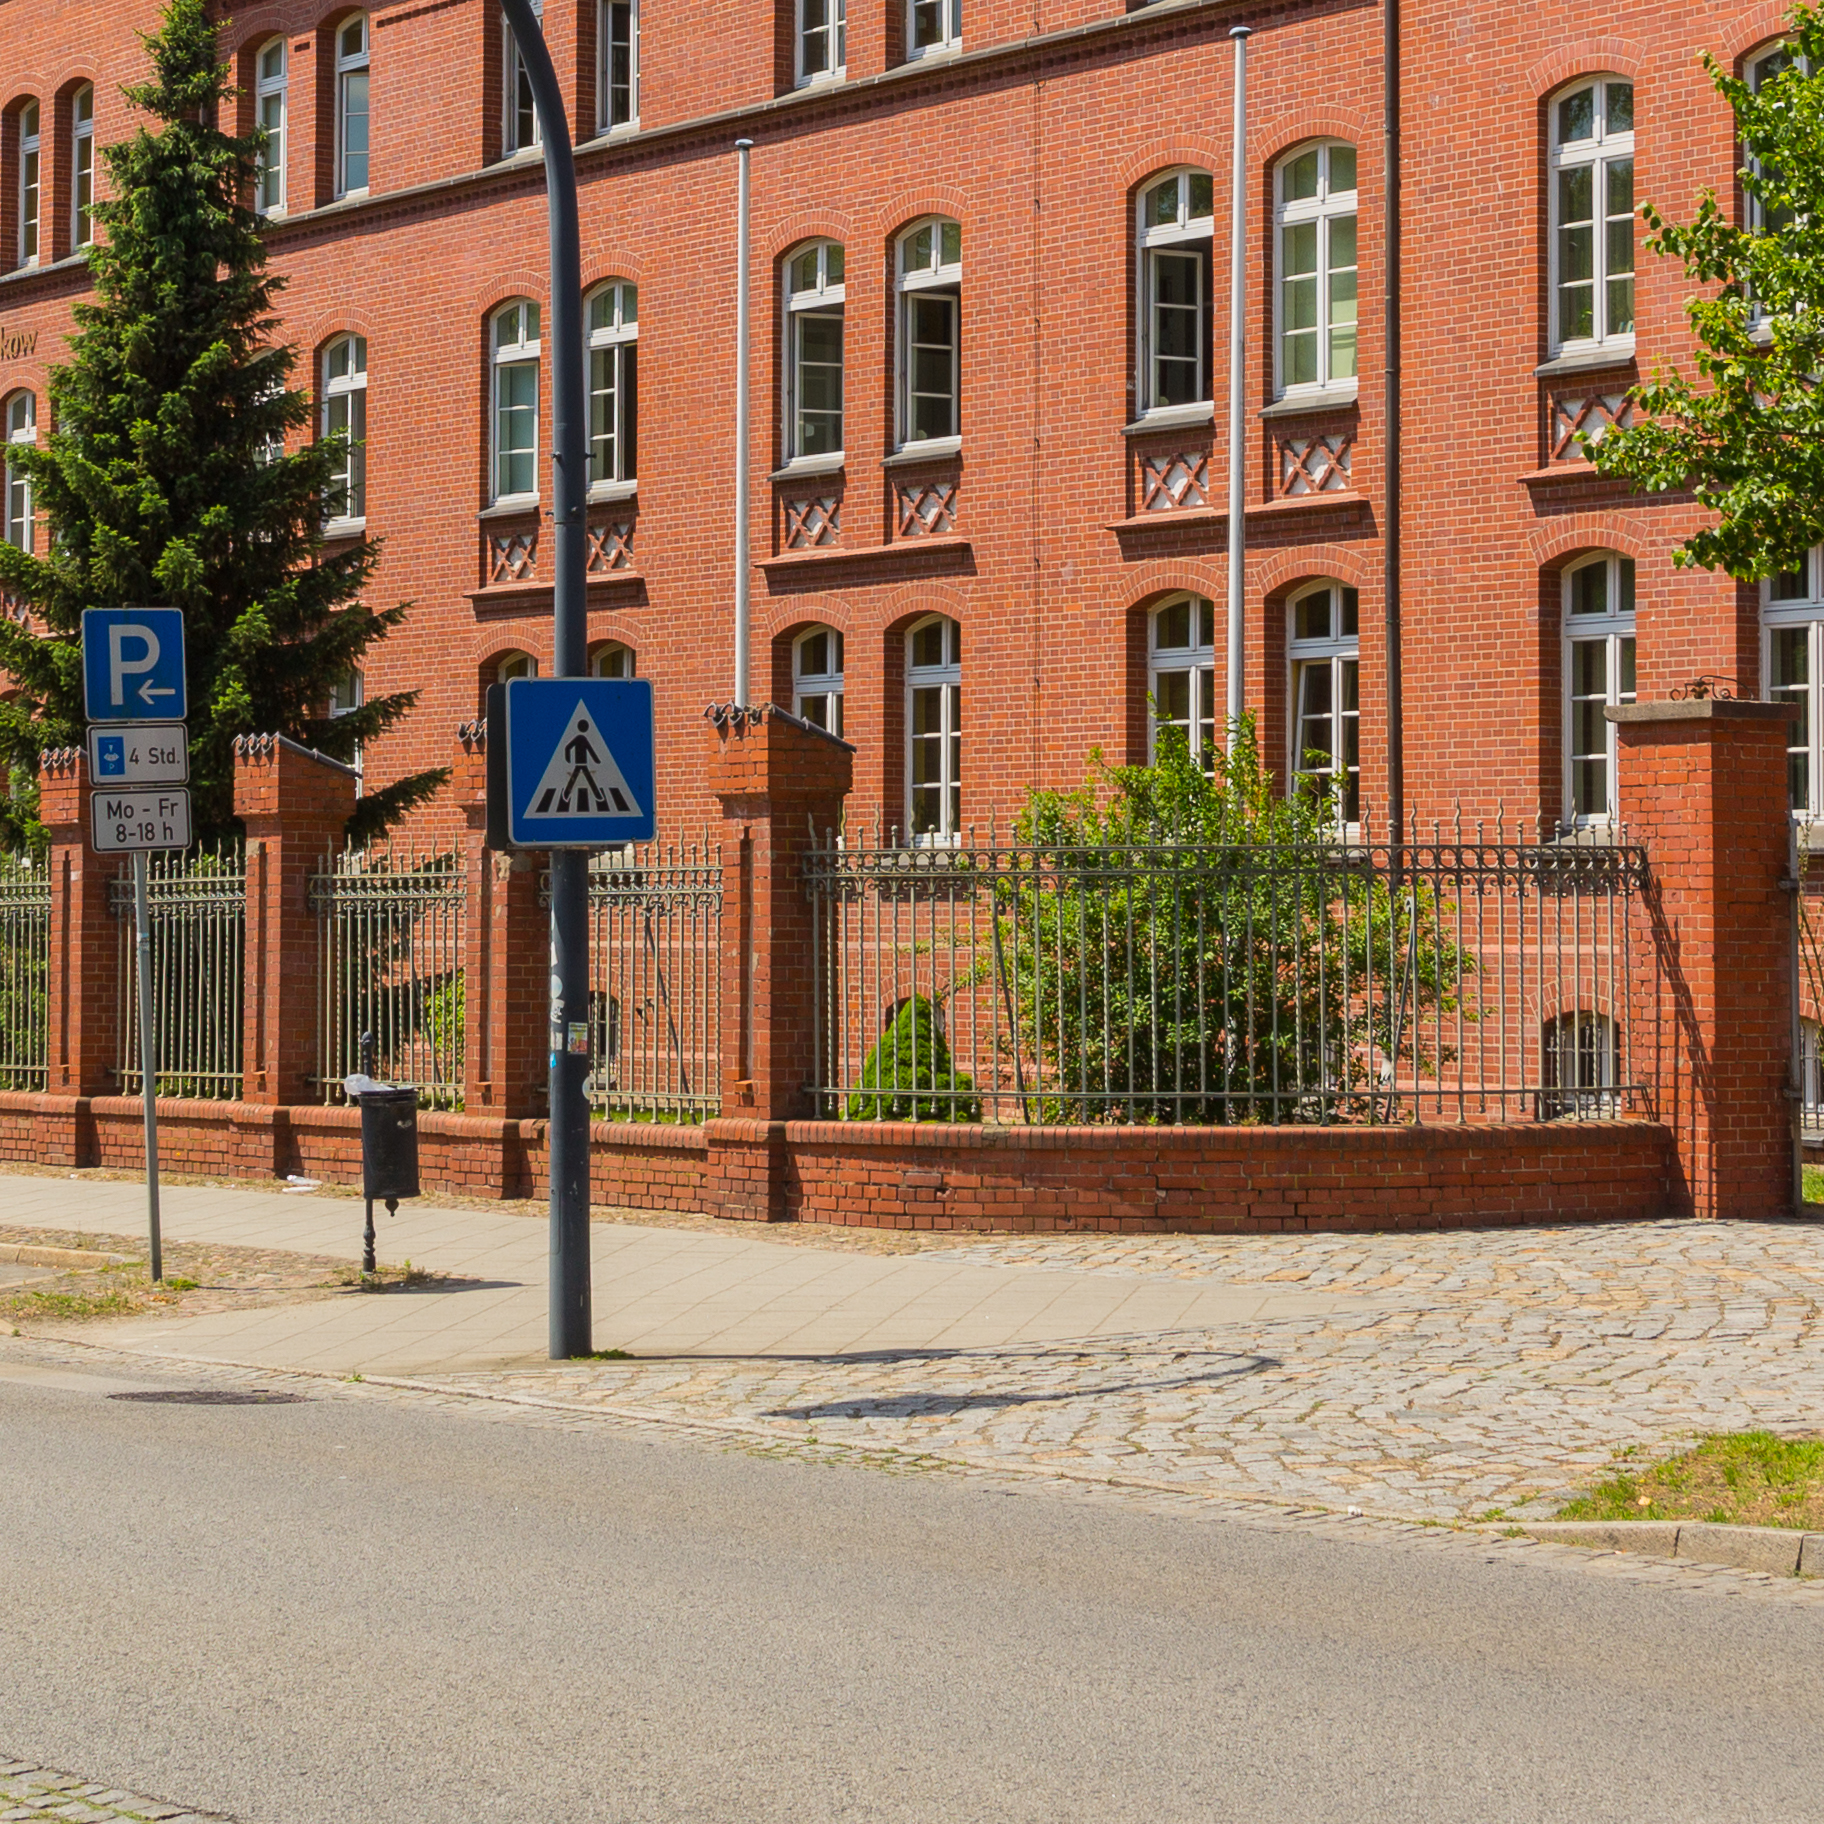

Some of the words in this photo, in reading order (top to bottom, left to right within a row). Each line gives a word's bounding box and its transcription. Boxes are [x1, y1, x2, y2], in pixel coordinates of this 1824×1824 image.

[108, 624, 161, 706] P
[129, 748, 140, 765] 4
[148, 747, 181, 765] Std.
[107, 800, 134, 821] Mo
[159, 798, 179, 818] Fr
[116, 823, 156, 843] 8-18
[163, 822, 174, 841] h
